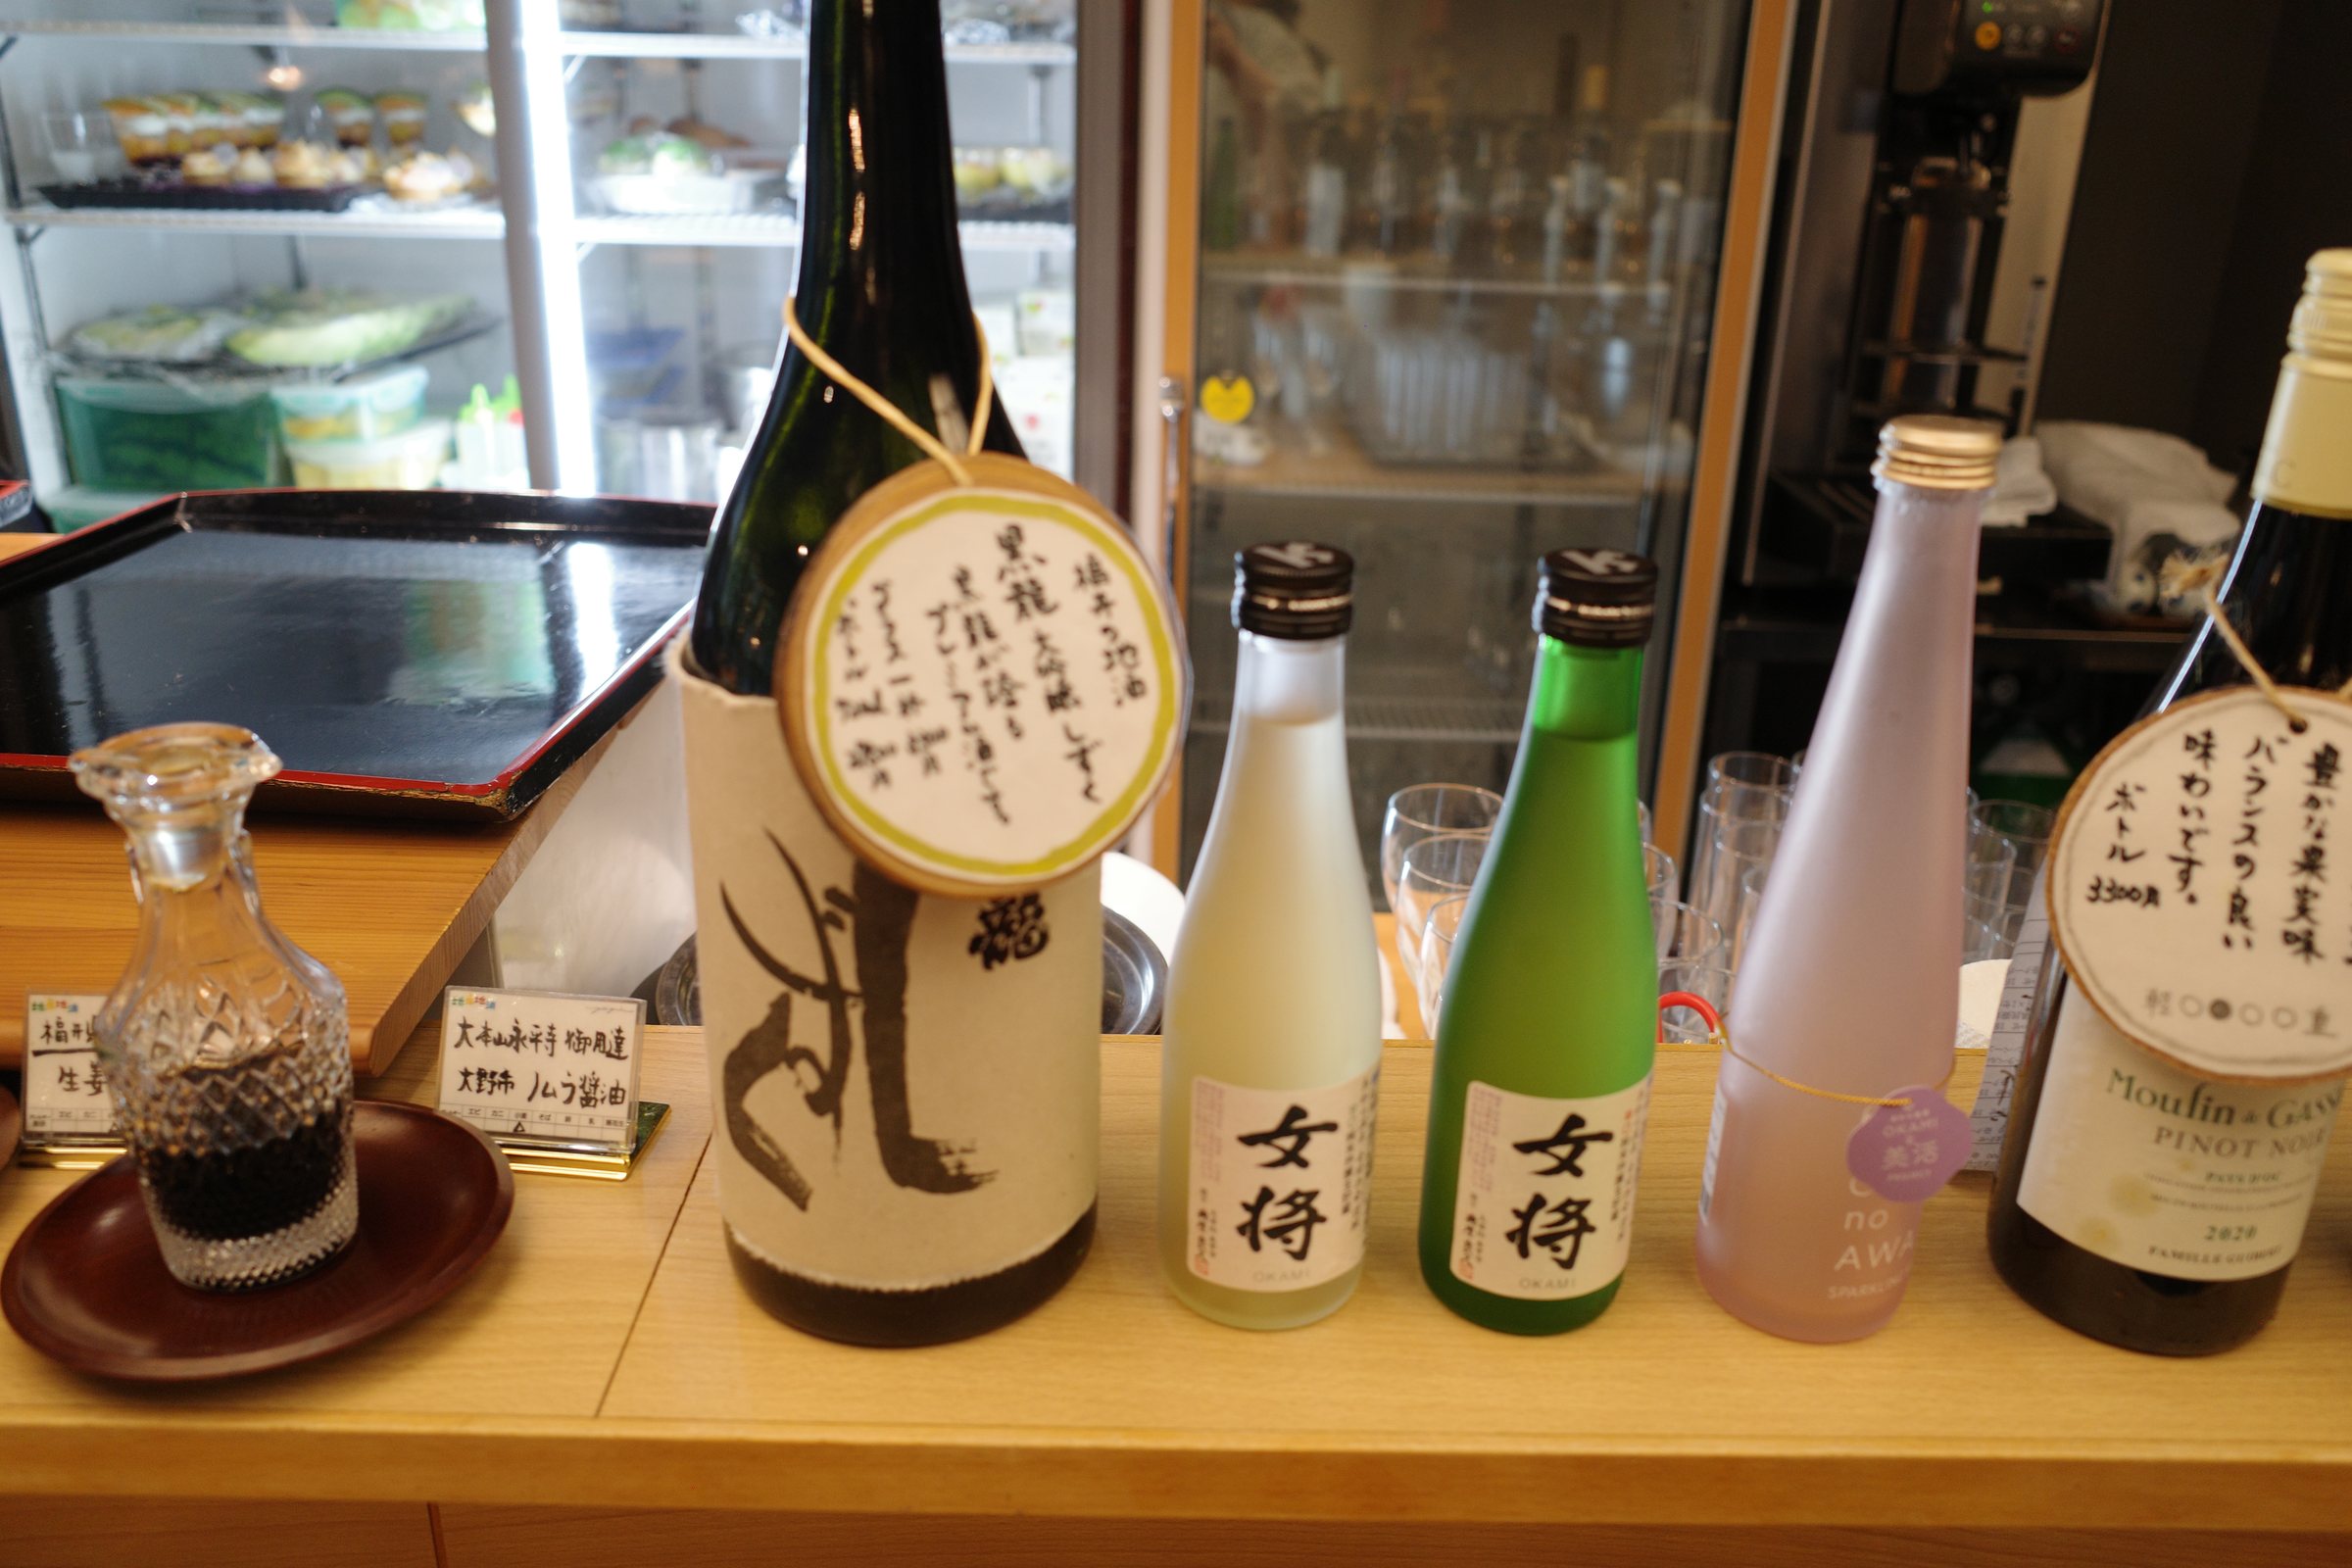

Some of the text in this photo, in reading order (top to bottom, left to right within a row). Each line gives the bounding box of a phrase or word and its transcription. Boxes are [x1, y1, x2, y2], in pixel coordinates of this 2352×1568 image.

[2221, 735, 2291, 951] バランスの良い
[2281, 742, 2342, 965] 豊かな果実味
[2106, 1067, 2237, 1126] Moulin
[2153, 1126, 2260, 1158] PINOT
[1237, 1103, 1339, 1261] 女将
[1504, 1112, 1614, 1270] 女将
[1844, 1209, 1889, 1230] no
[2204, 1225, 2258, 1241] 2020
[1519, 1276, 1578, 1291] OKAMI
